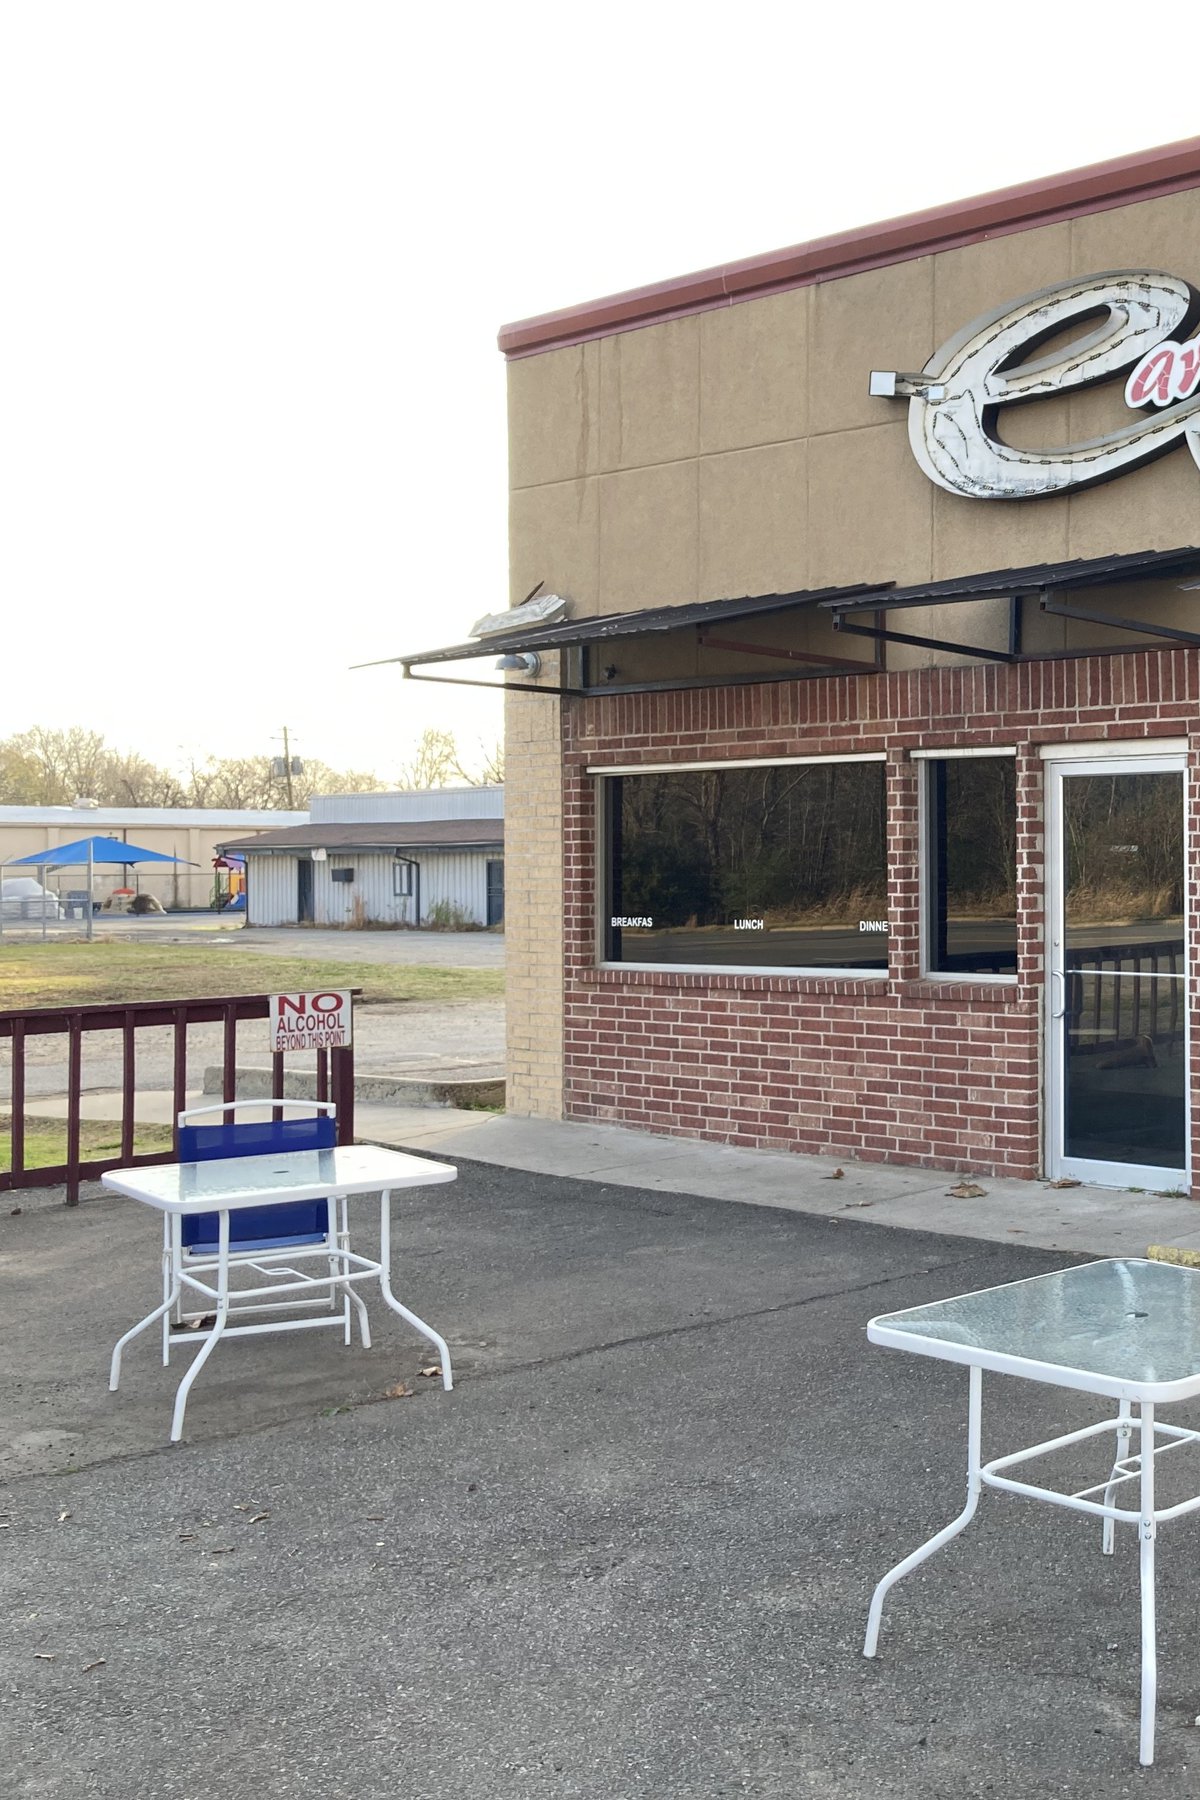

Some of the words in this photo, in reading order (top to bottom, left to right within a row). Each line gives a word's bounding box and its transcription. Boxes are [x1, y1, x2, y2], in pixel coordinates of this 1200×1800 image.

[734, 919, 764, 930] LUNCH
[859, 920, 889, 931] DINNE
[278, 993, 343, 1016] NO
[277, 1013, 345, 1033] ALCOHOL
[276, 1033, 306, 1051] BEYOND
[307, 1032, 323, 1049] THIS
[325, 1030, 345, 1047] POINT
